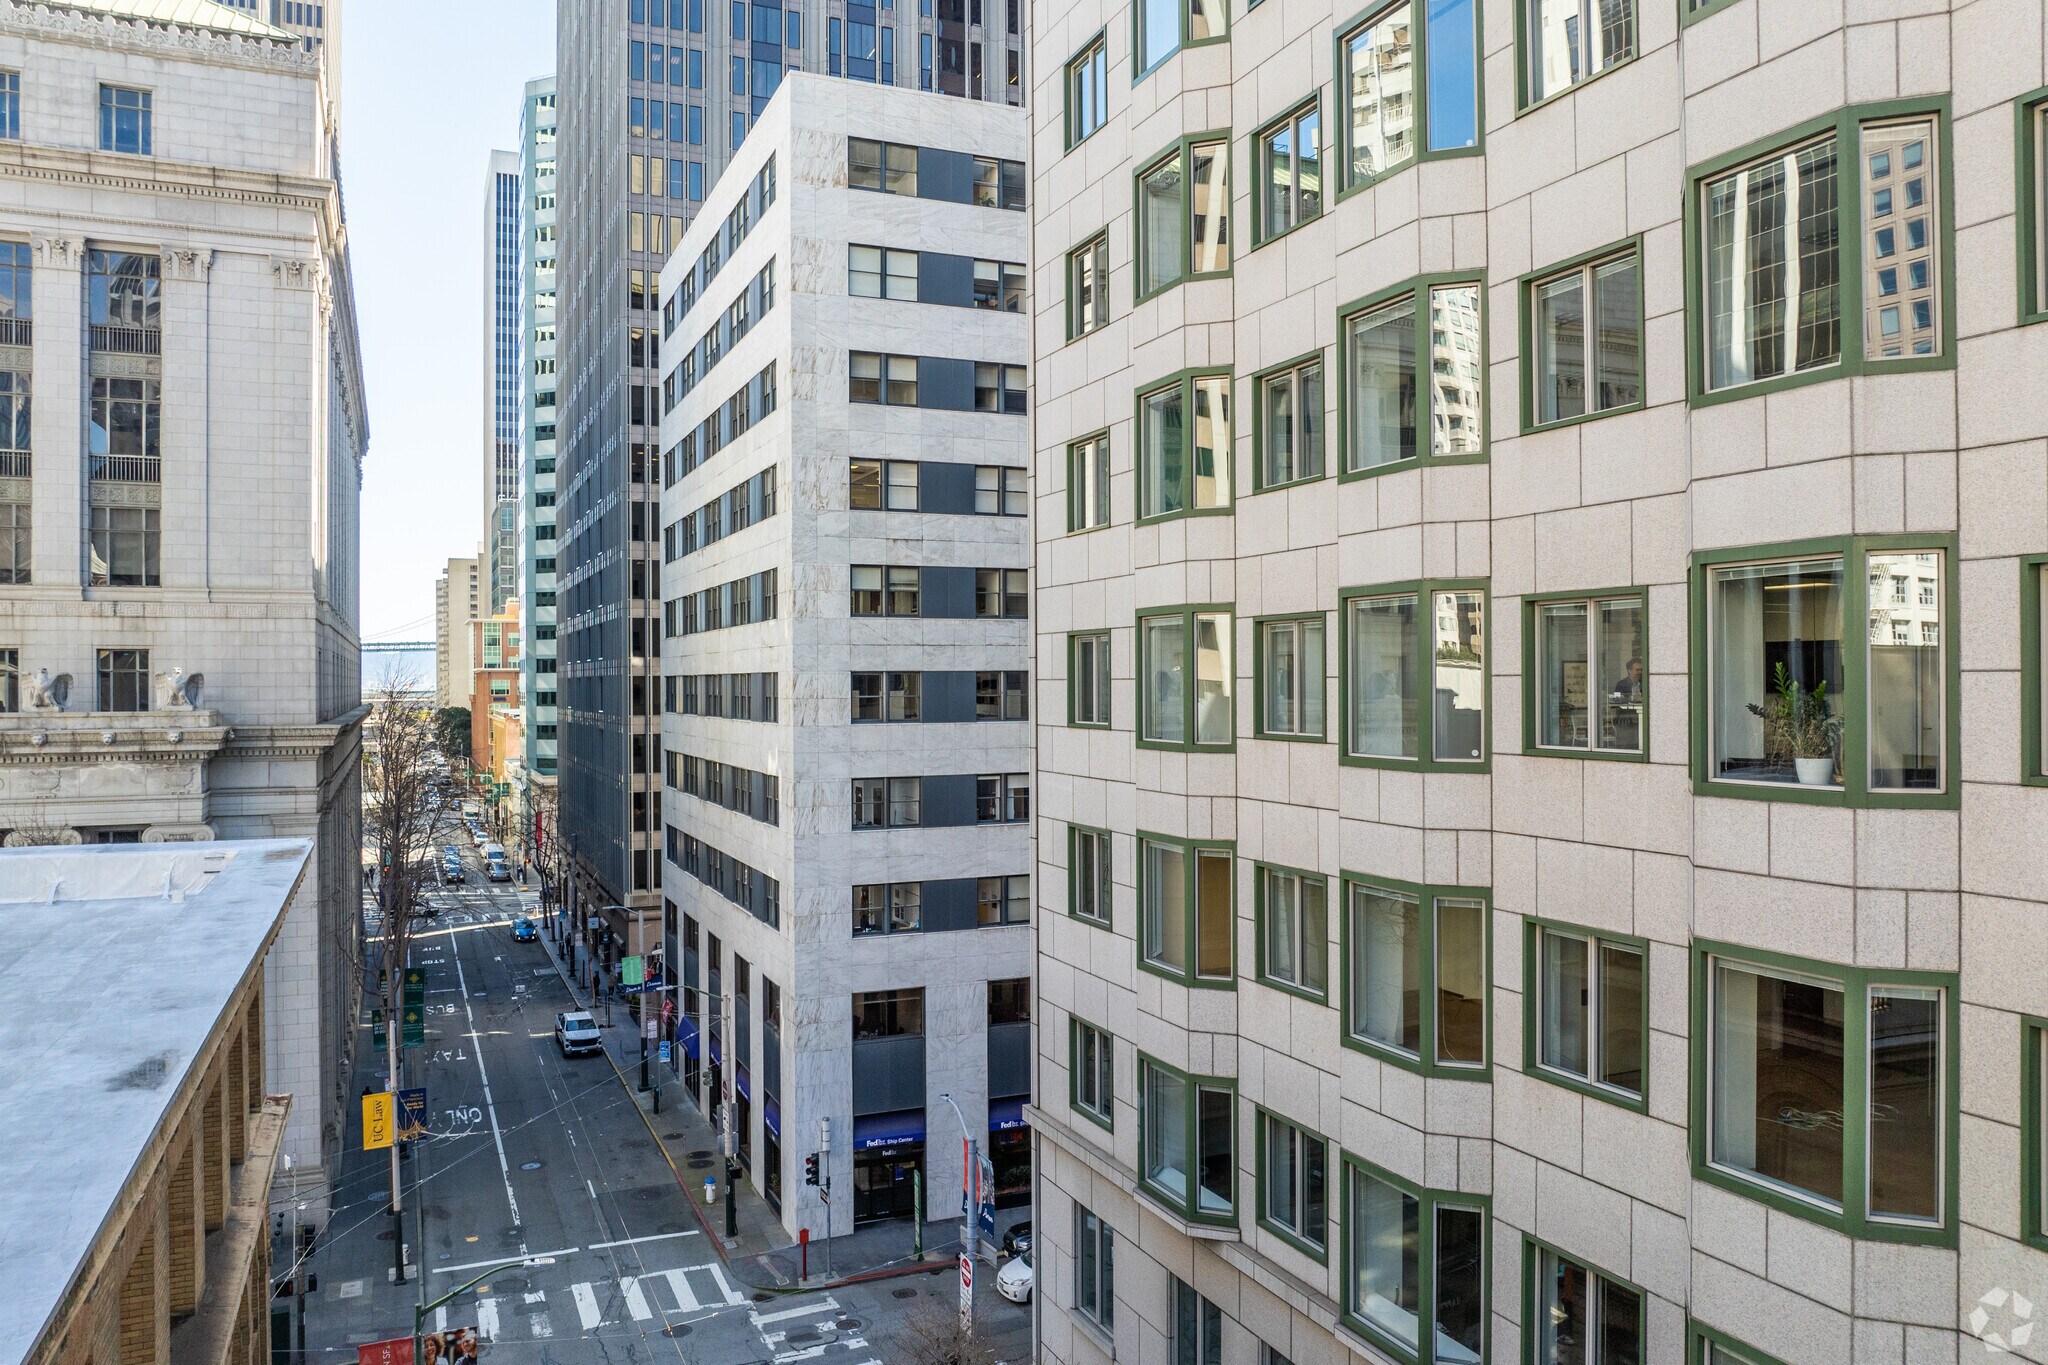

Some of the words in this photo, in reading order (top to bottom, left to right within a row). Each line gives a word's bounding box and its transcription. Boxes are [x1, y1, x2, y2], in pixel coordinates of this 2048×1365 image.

[425, 1003, 455, 1016] BUS
[373, 1100, 384, 1121] Law
[1000, 1120, 1019, 1129] FedEx
[373, 1126, 384, 1142] UC
[866, 1138, 886, 1147] FedEx
[882, 1149, 897, 1157] FedEx
[382, 1350, 390, 1359] SF
